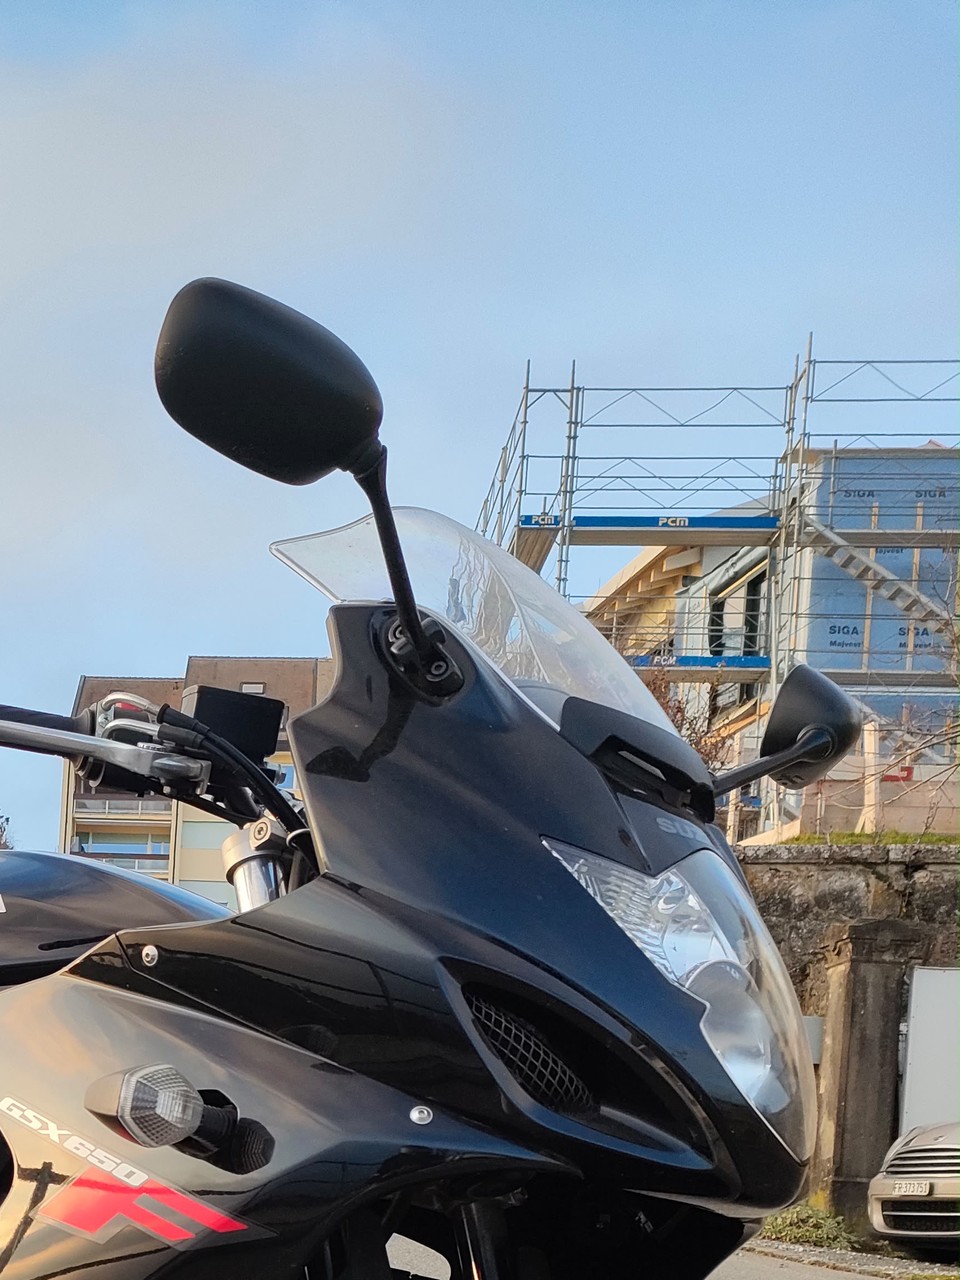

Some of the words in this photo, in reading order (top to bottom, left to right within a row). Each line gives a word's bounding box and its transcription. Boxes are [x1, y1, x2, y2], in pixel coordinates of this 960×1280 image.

[844, 489, 876, 499] SIGA
[915, 489, 947, 499] SIGA
[531, 515, 555, 525] PCM
[658, 517, 689, 527] PCM
[828, 625, 859, 636] SIGA
[653, 656, 677, 666] PCM
